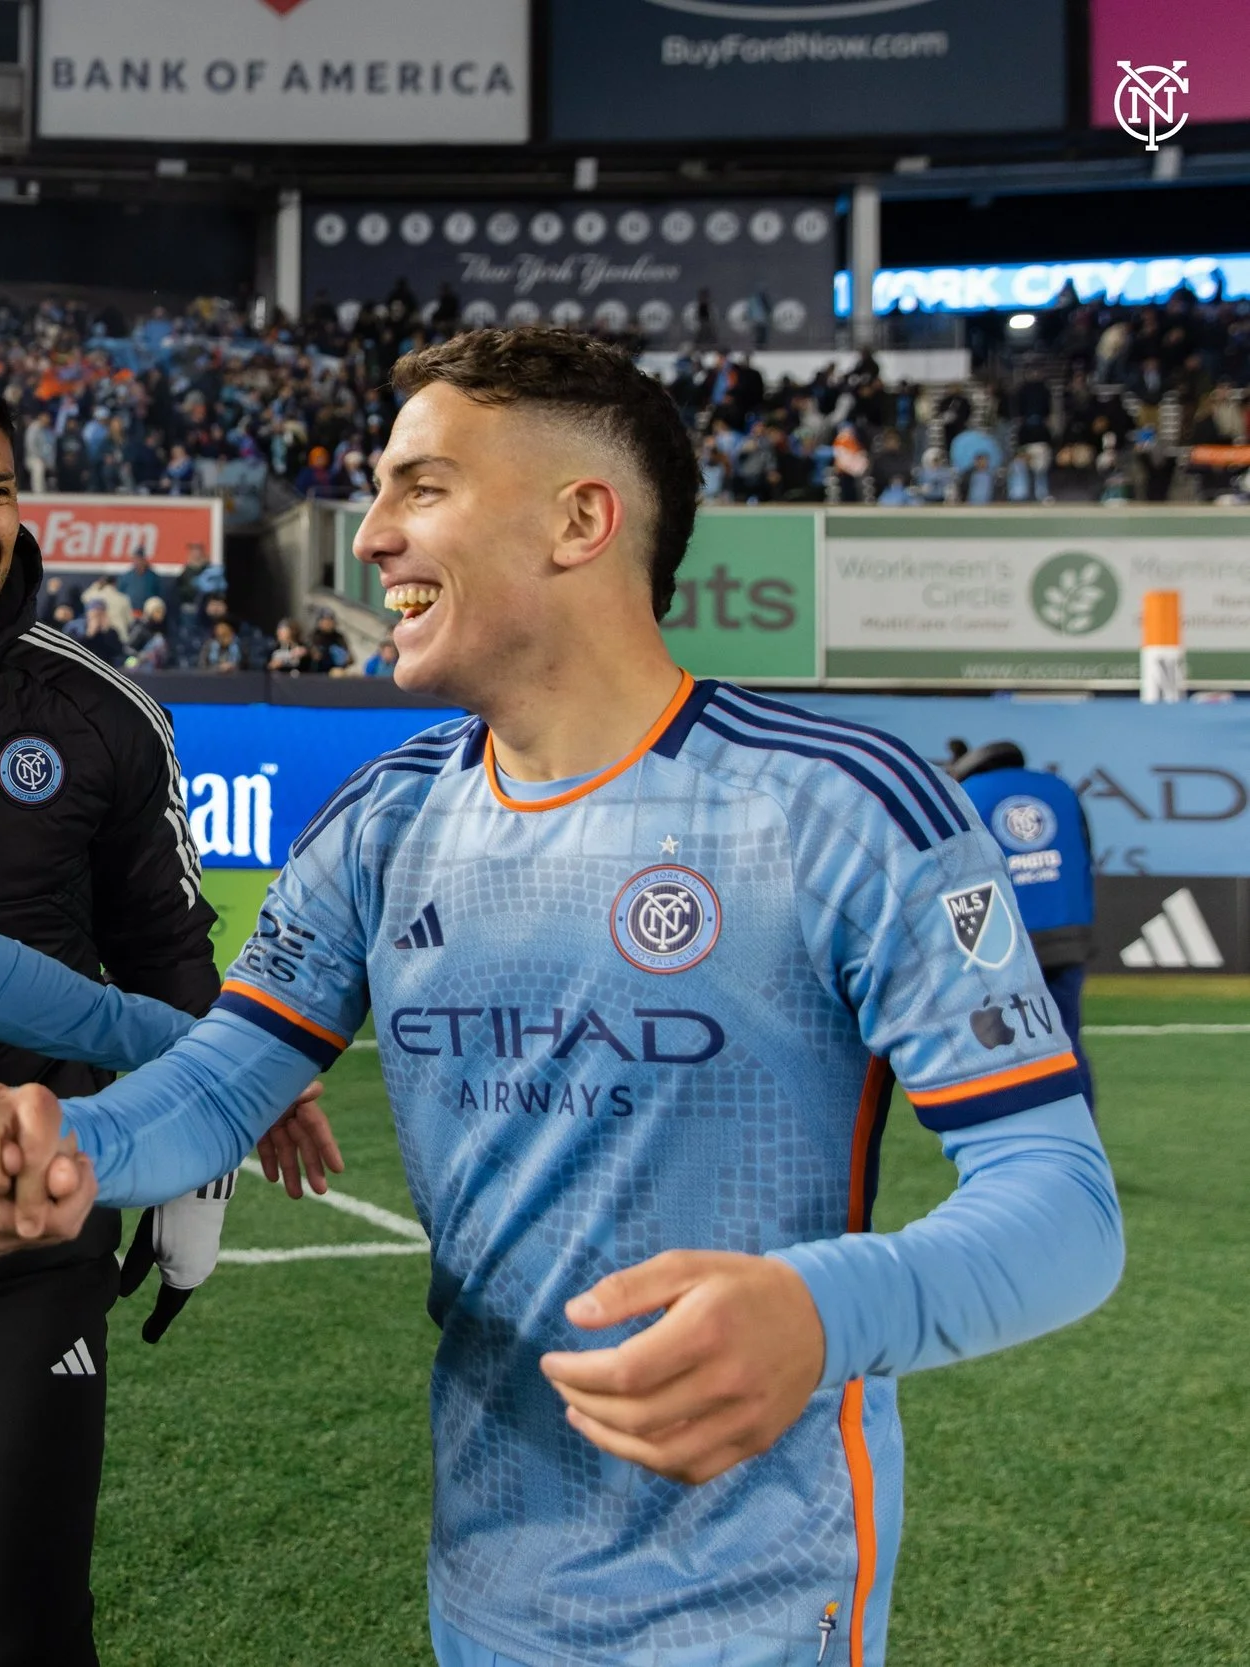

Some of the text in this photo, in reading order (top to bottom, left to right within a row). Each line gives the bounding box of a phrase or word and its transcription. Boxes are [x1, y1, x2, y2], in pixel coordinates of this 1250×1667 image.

[661, 31, 949, 69] BuyFordNow.com
[52, 57, 515, 96] BANK OF AMERICA
[36, 510, 160, 560] Farm
[661, 564, 797, 632] ats
[6, 744, 18, 754] NEW
[36, 741, 50, 752] CITY
[12, 785, 56, 800] FOOTBALL CLUB
[631, 871, 703, 893] NEW YORK CITY
[950, 892, 985, 917] MLS
[626, 944, 702, 967] FOOTBALL CLUB
[390, 1007, 725, 1064] ETIHAD
[459, 1079, 634, 1118] AIRWAYS
